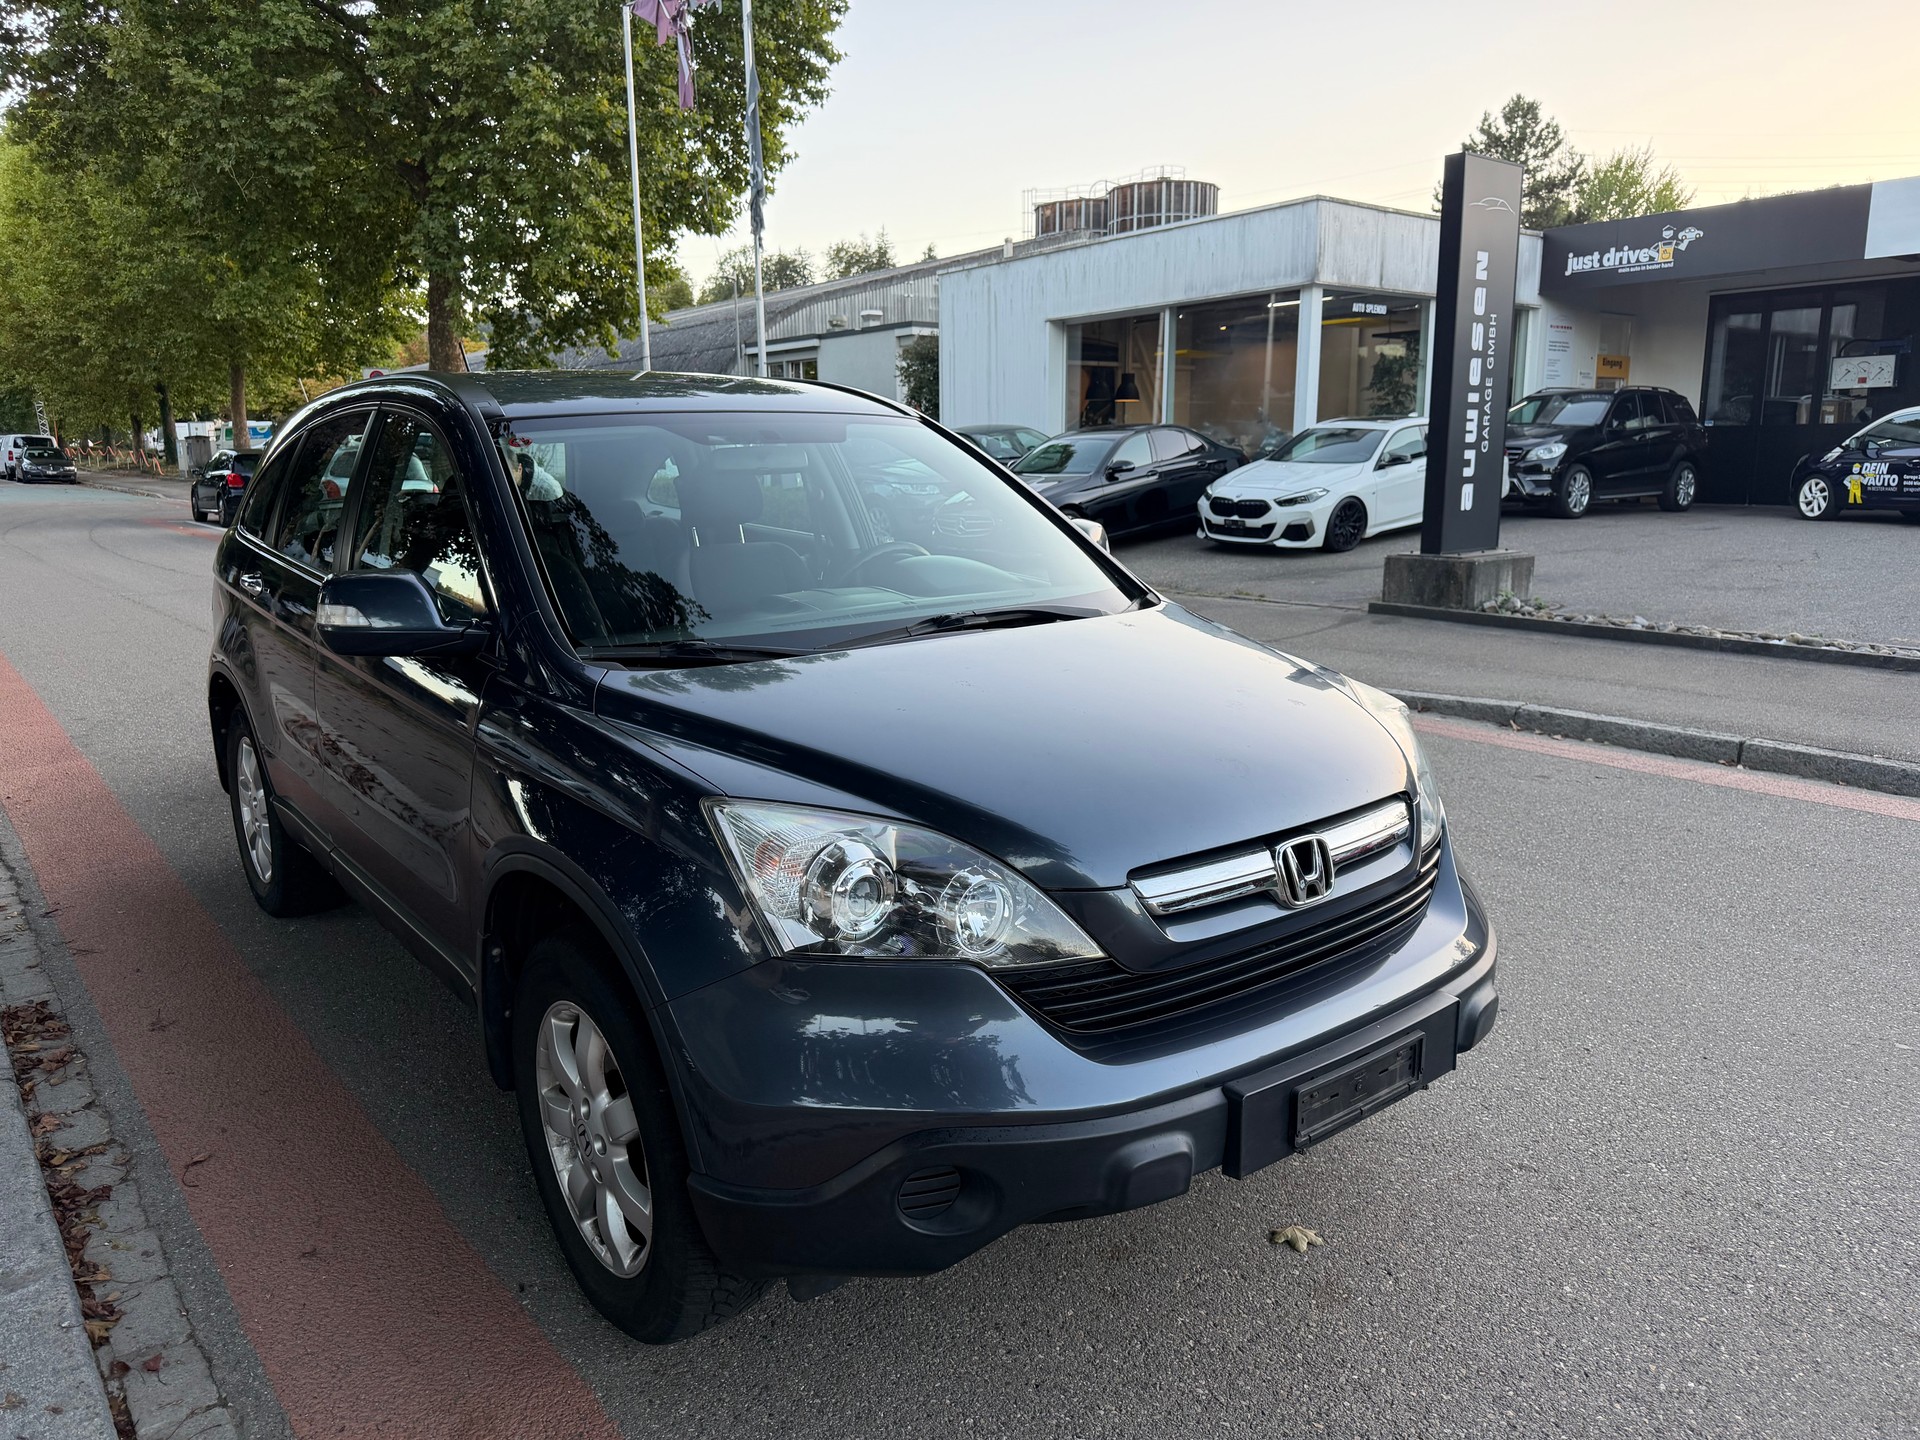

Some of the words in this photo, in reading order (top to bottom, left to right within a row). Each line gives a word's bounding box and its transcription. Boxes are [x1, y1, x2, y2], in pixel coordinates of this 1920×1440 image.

[1565, 251, 1600, 276] just
[1602, 245, 1651, 268] drive
[1486, 313, 1497, 370] GMBH
[1602, 357, 1623, 370] Eingang
[1481, 377, 1494, 453] GARAGE
[1861, 462, 1890, 474] DEIN
[1867, 474, 1899, 487] AUTO
